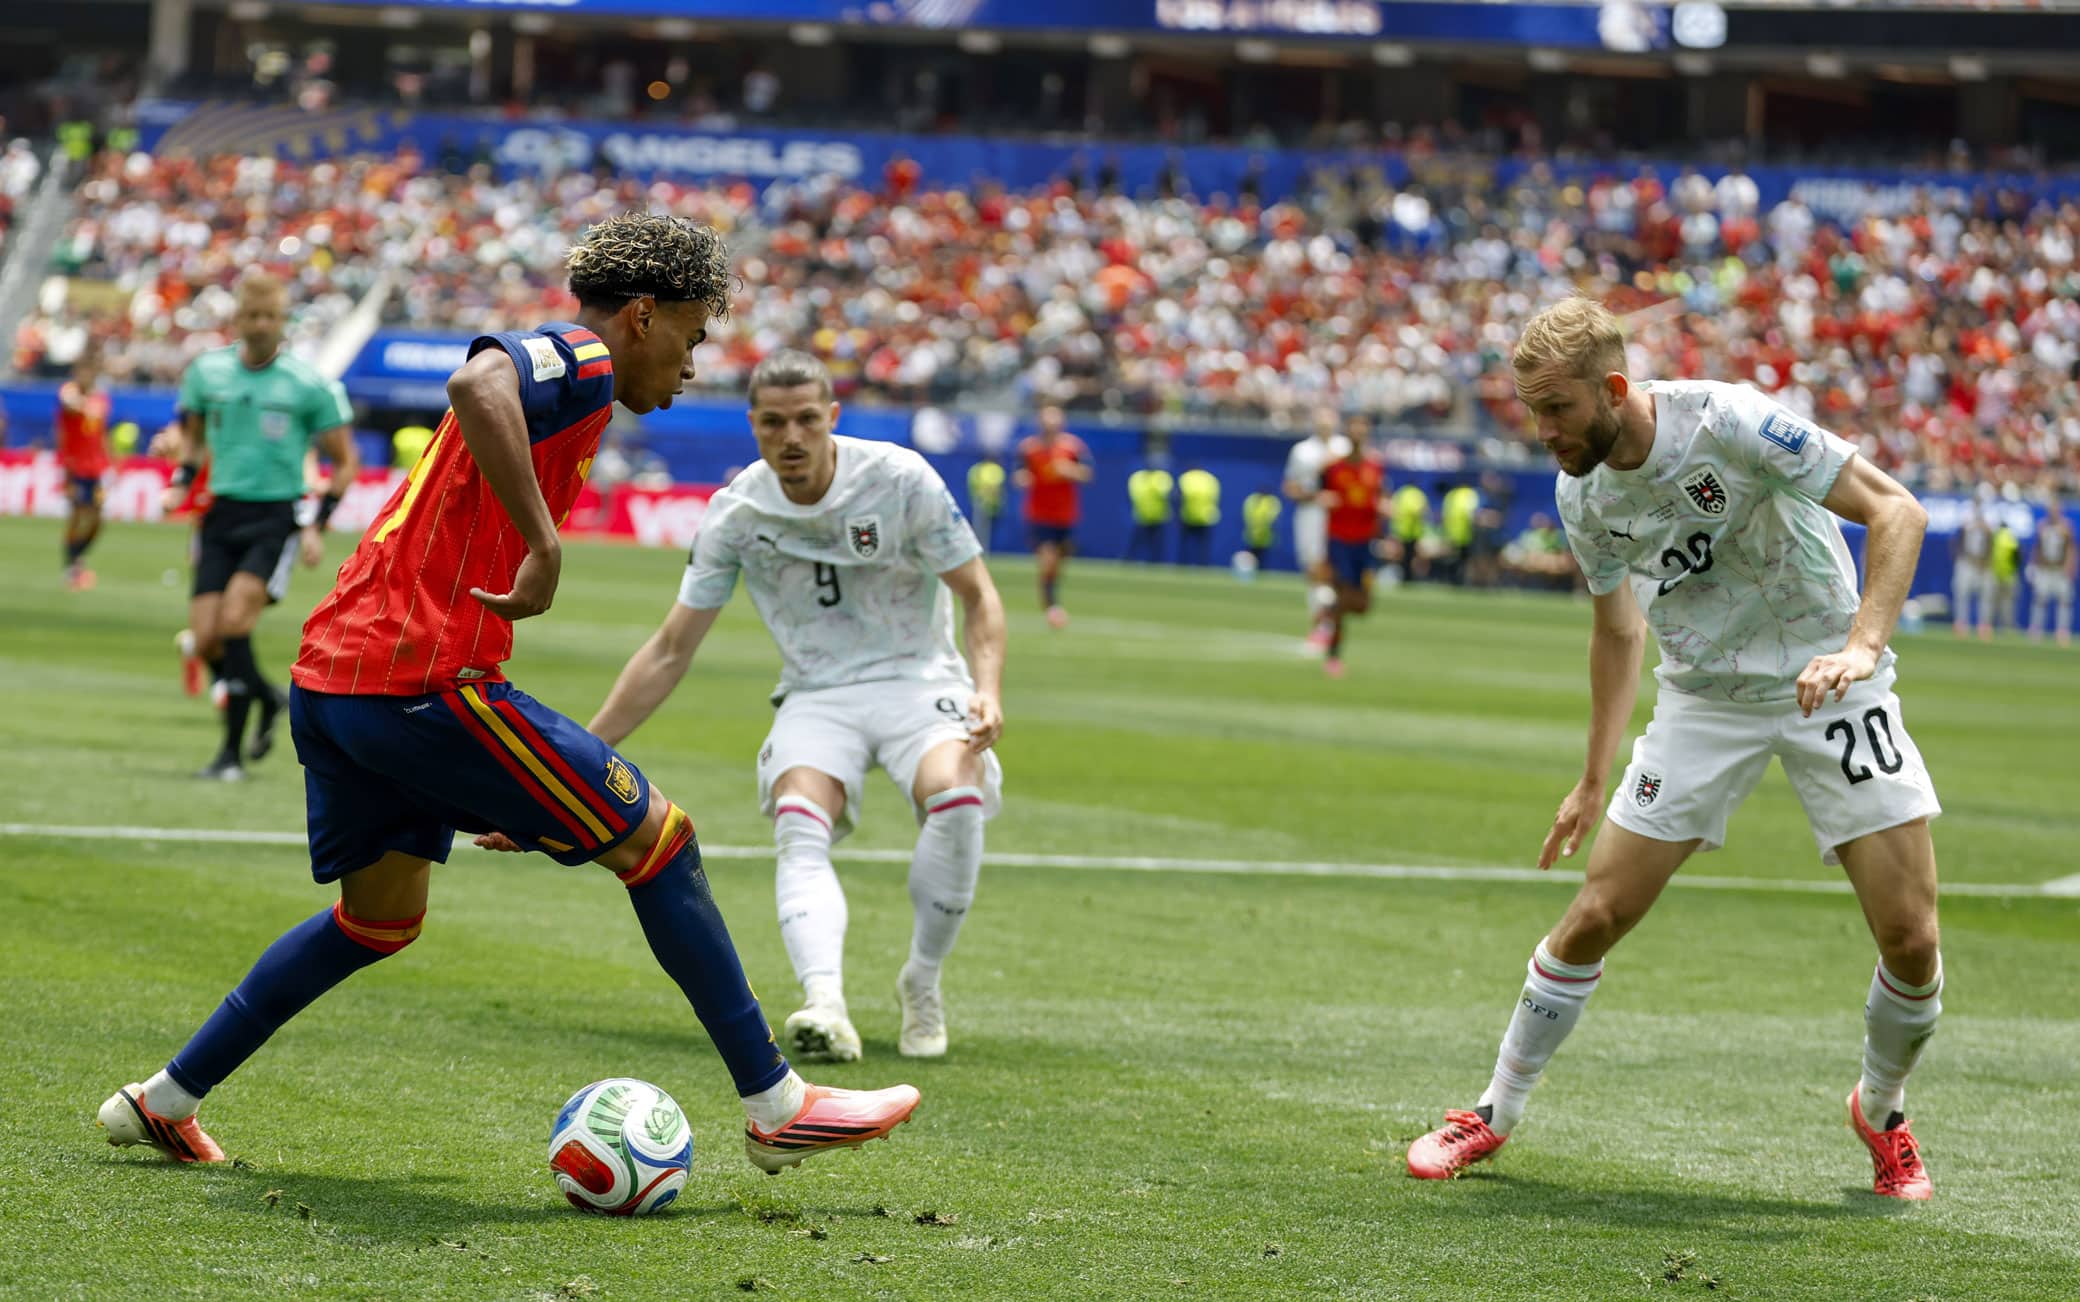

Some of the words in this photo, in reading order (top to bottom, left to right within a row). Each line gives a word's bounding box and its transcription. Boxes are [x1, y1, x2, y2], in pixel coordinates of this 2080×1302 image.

[815, 562, 841, 607] 9
[1658, 531, 1713, 597] 20
[1825, 706, 1903, 785] 20
